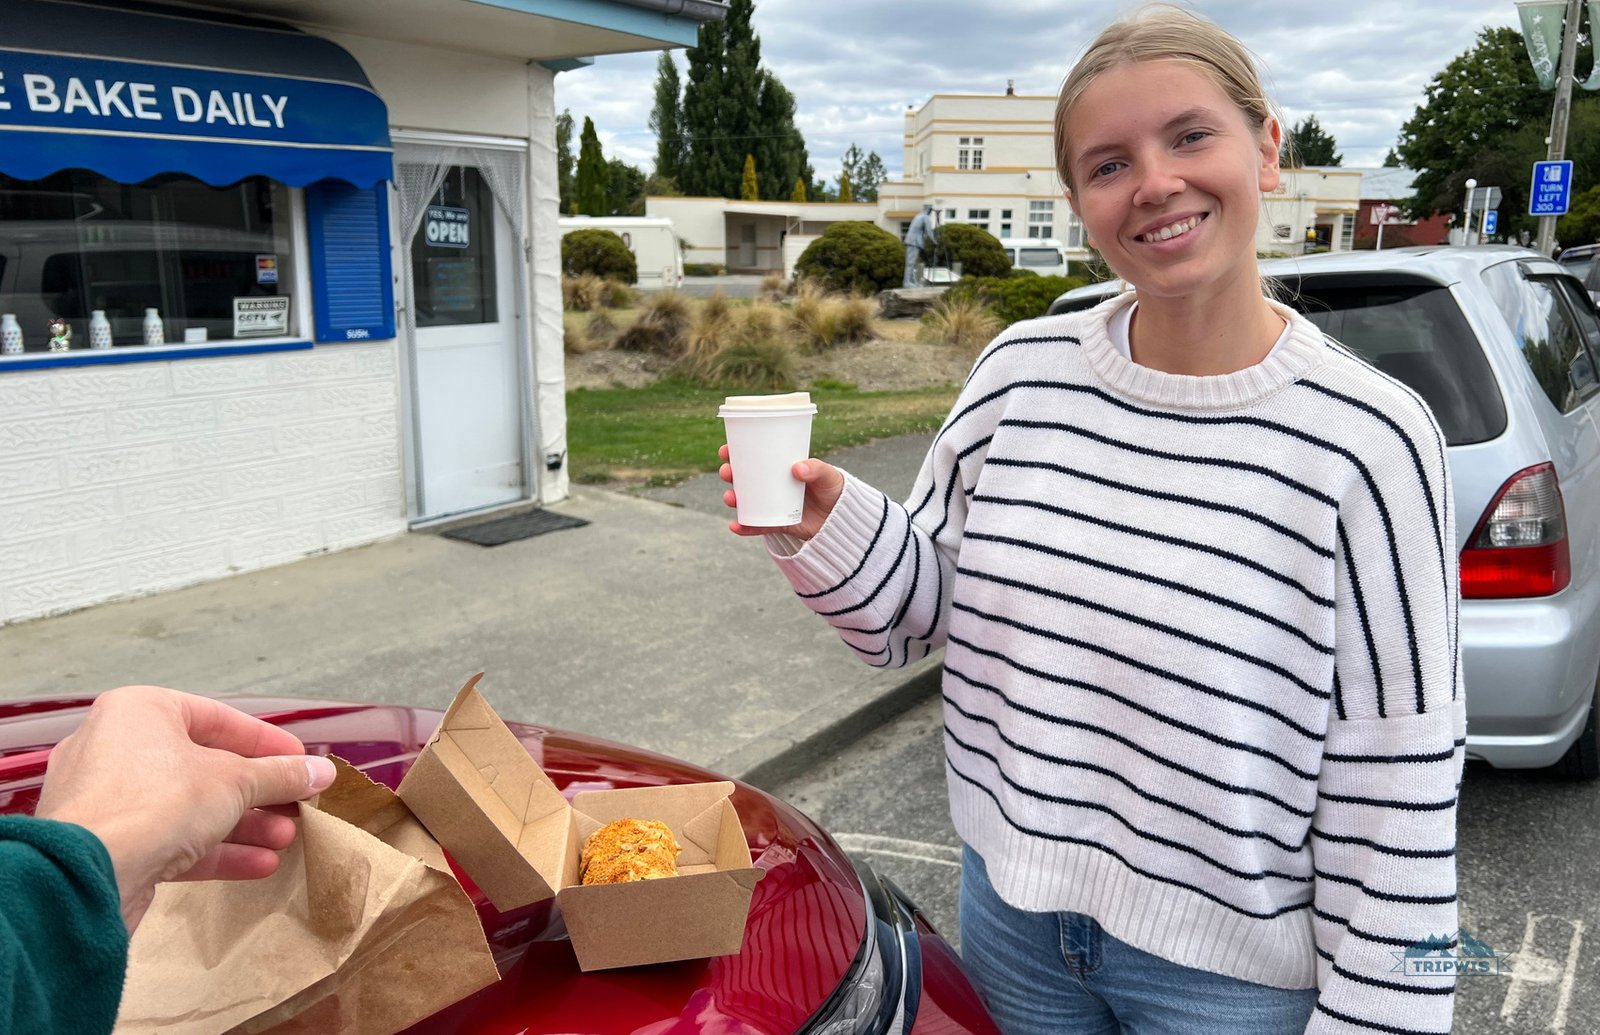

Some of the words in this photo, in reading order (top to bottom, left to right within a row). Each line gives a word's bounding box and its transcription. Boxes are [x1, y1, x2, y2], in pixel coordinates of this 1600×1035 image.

[23, 74, 163, 120] BAKE
[171, 86, 289, 129] DAILY
[1540, 184, 1564, 192] TURN
[1538, 193, 1561, 202] LEFT
[427, 221, 469, 243] OPEN
